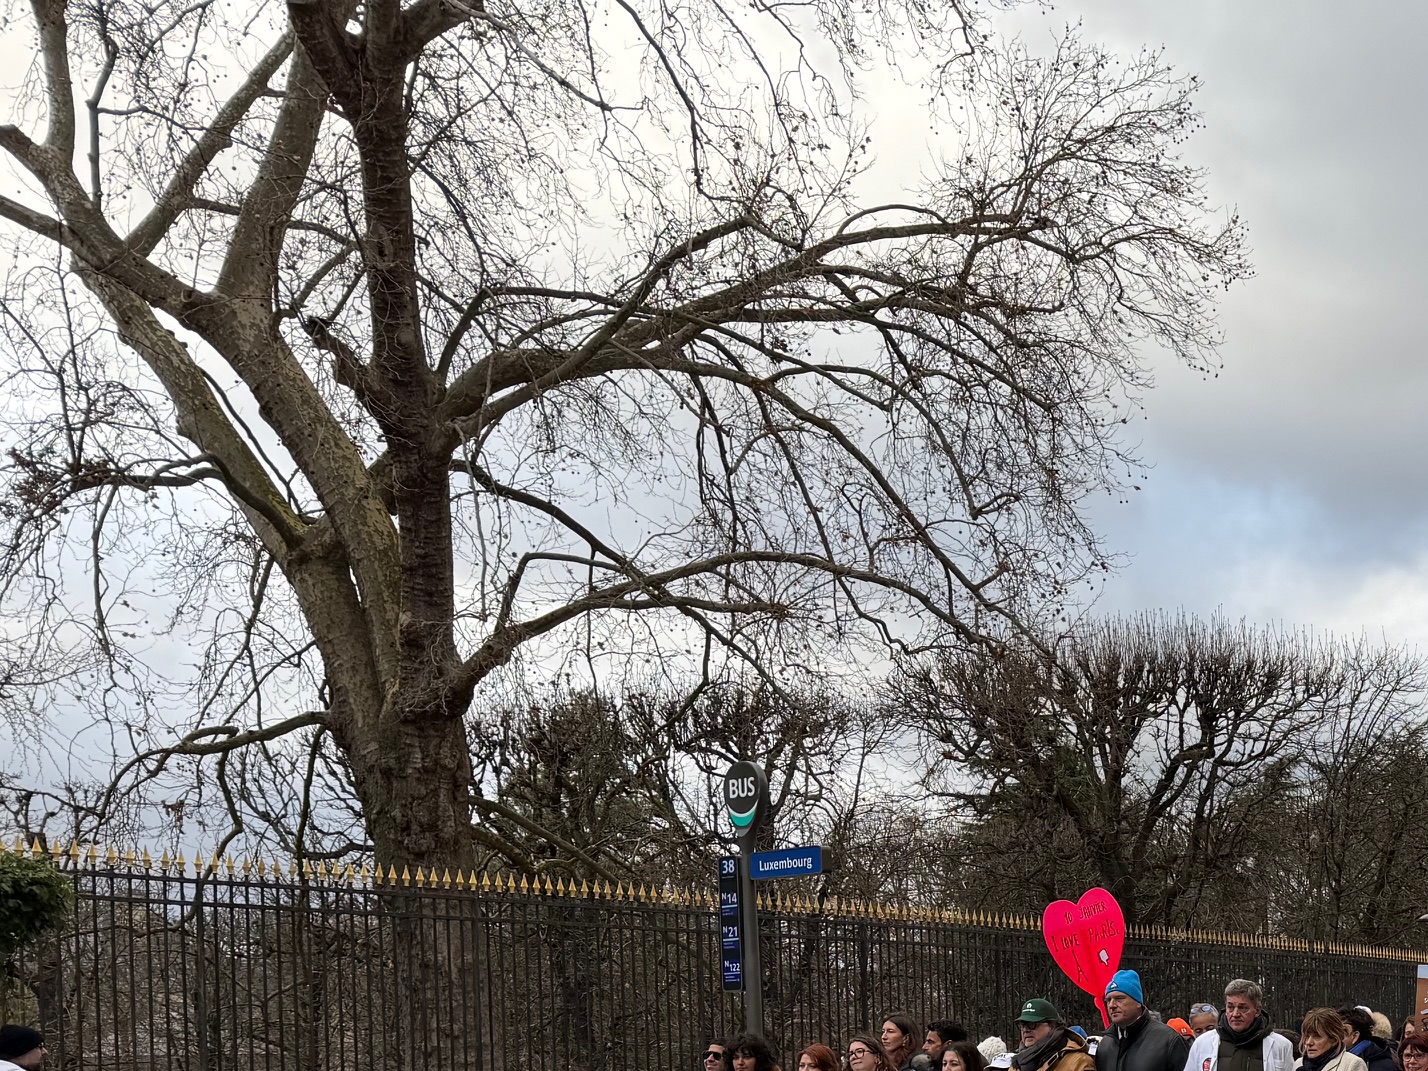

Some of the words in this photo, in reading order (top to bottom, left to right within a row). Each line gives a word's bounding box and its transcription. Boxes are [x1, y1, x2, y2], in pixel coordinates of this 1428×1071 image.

[729, 777, 755, 798] BUS
[722, 860, 735, 874] 38
[759, 856, 812, 871] Luxembourg
